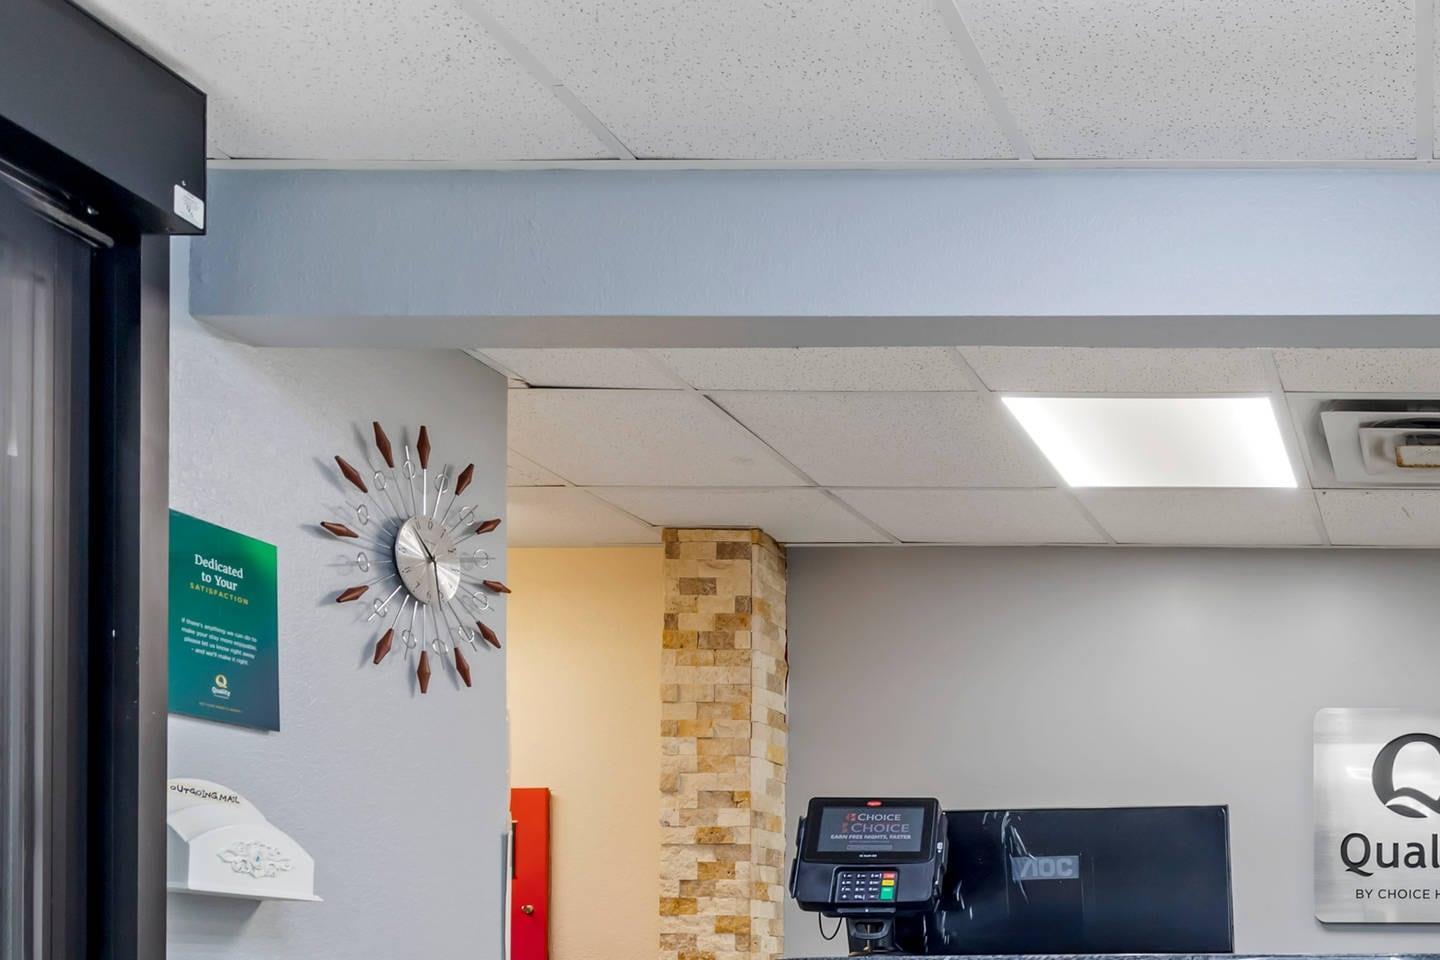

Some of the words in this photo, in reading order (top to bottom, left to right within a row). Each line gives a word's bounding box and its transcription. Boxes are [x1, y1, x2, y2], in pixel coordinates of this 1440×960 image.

[194, 553, 244, 580] Dedicated
[201, 570, 212, 583] to
[213, 574, 238, 591] Your
[189, 581, 249, 606] SATISFACTION
[169, 783, 218, 800] OUTGOING
[219, 793, 241, 805] MAIL
[857, 813, 902, 821] CHOICE
[851, 823, 911, 833] CHOICE
[1355, 889, 1374, 900] BY
[1378, 889, 1431, 900] CHOICE
